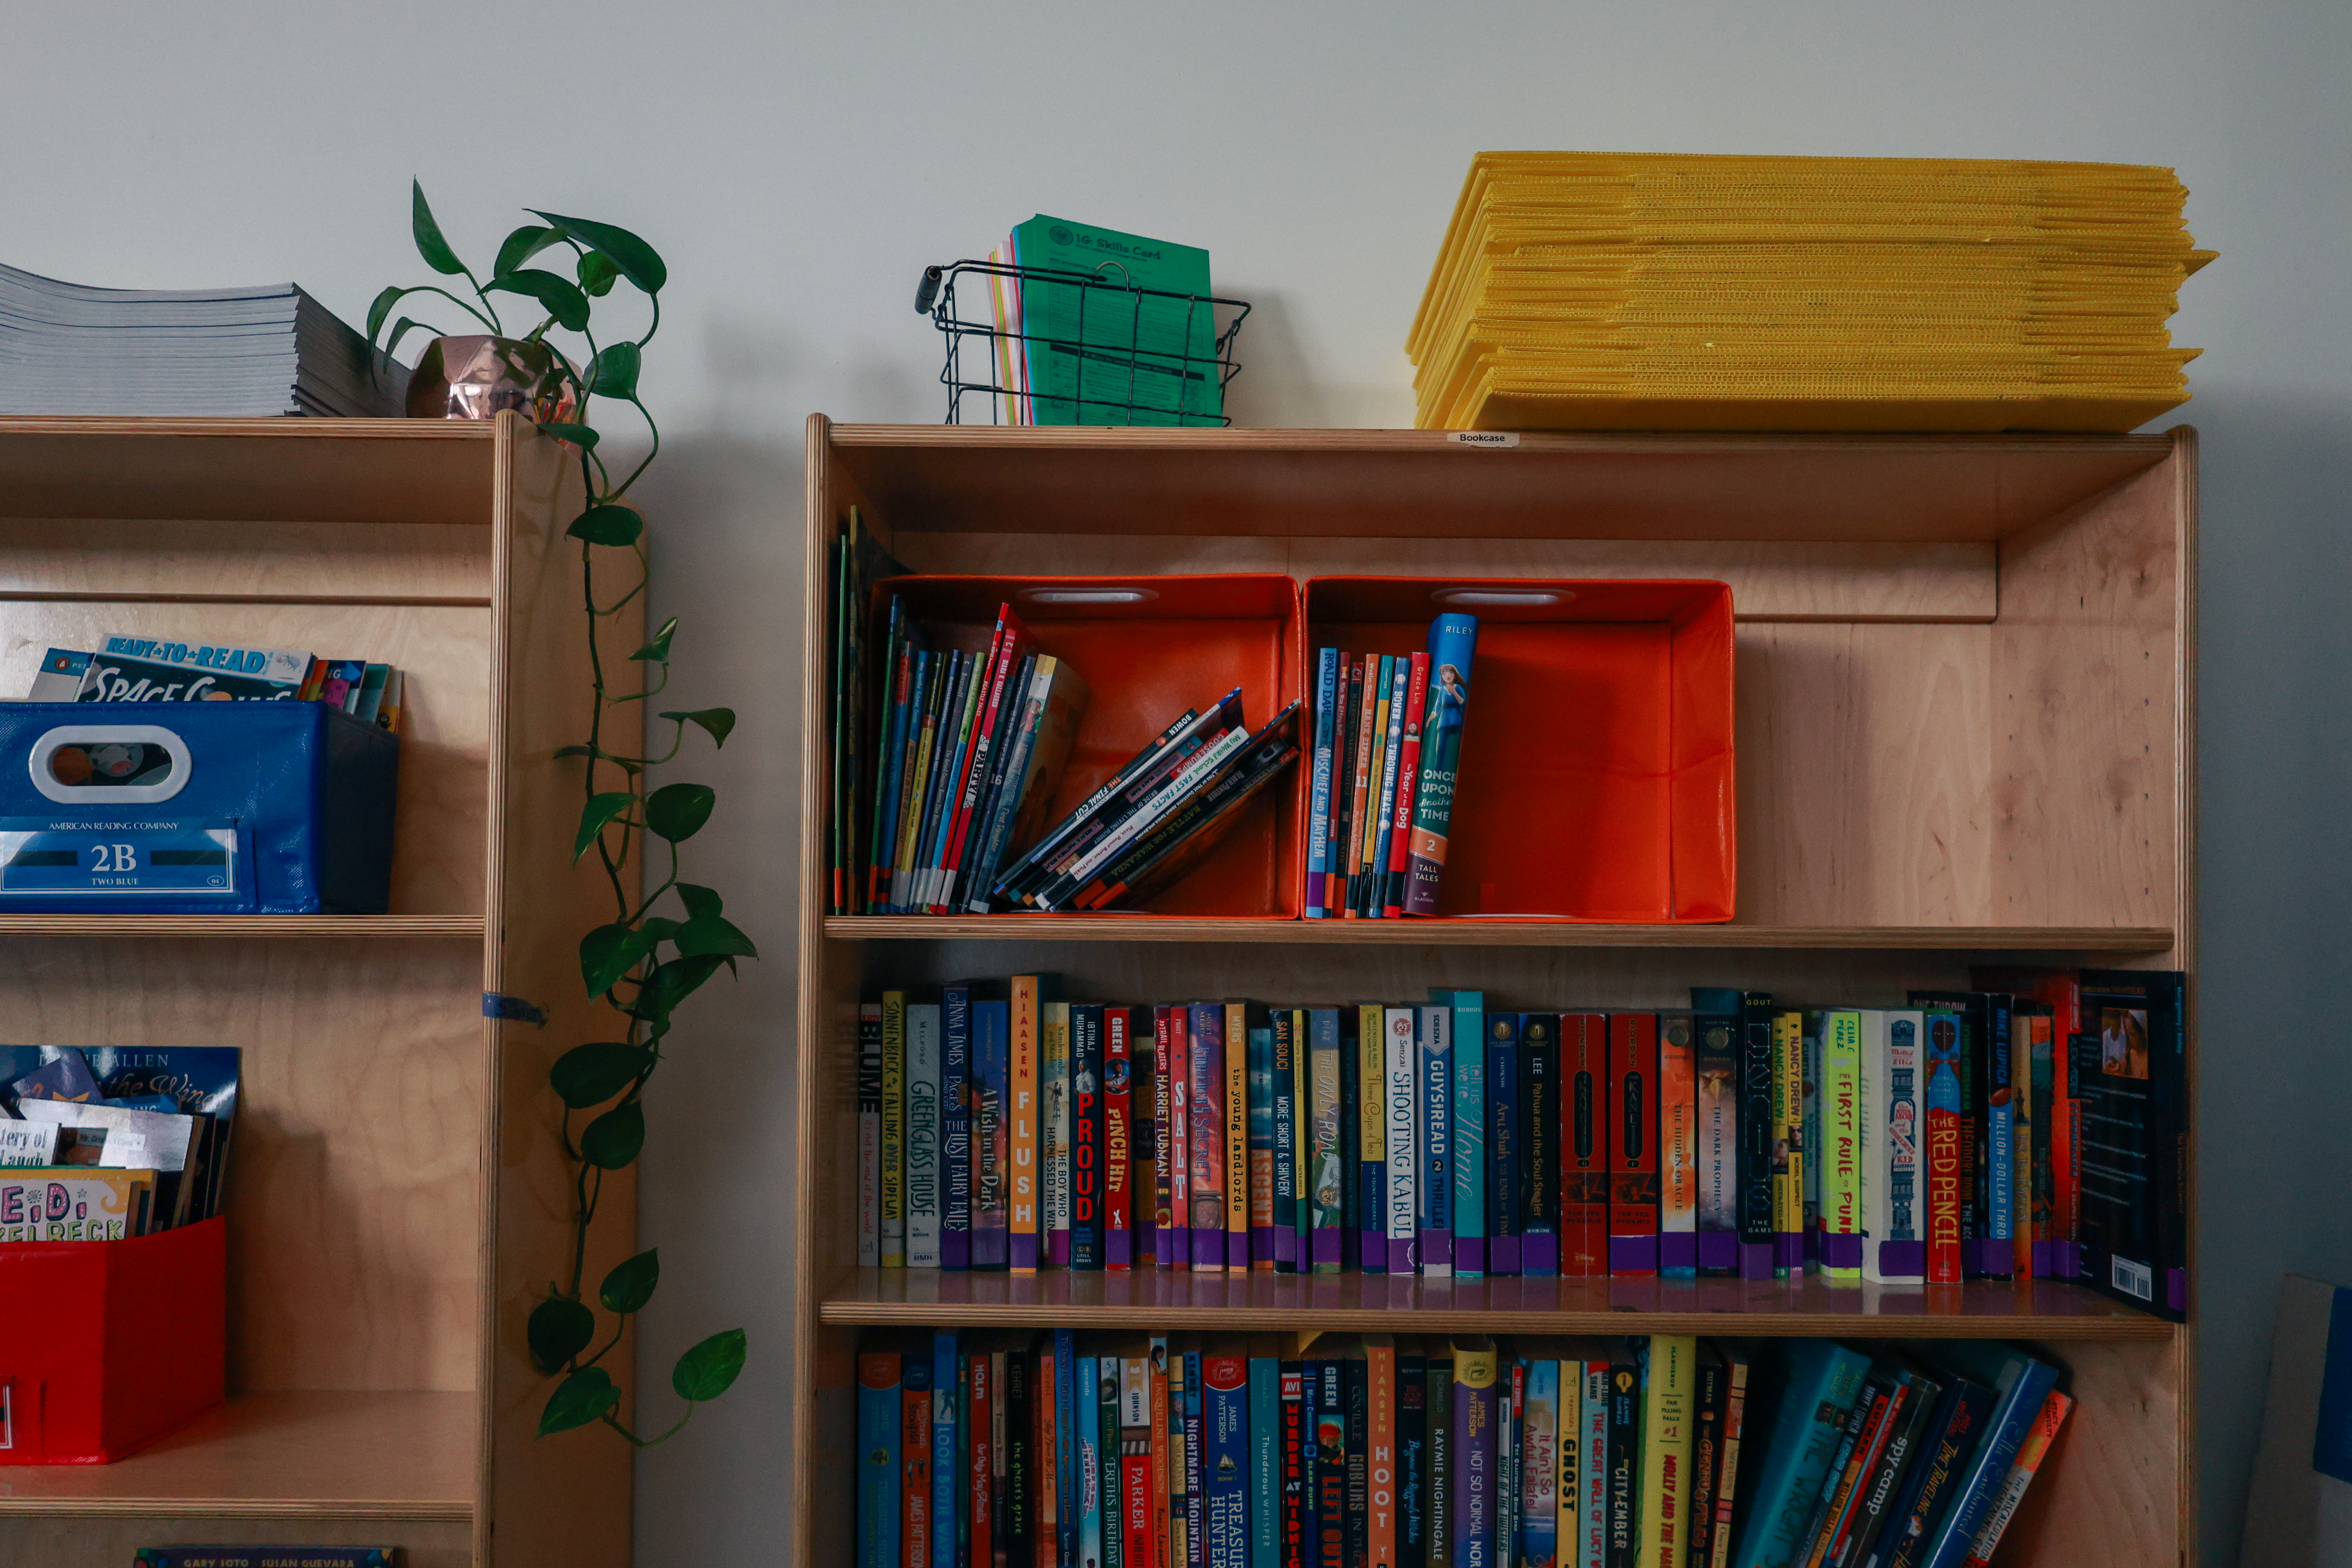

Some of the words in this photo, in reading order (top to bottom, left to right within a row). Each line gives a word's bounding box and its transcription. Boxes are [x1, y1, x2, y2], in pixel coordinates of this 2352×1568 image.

[1097, 239, 1128, 253] Skills
[1132, 247, 1161, 260] Card
[1445, 625, 1473, 636] RILEY
[106, 637, 154, 658] READY
[162, 643, 188, 662] TO
[197, 647, 267, 674] READ
[1323, 652, 1334, 686] ROALD
[95, 668, 183, 702] SPACE
[980, 681, 988, 699] BEASTLY
[1414, 666, 1423, 691] Grace
[1321, 690, 1333, 718] DAHL
[1391, 691, 1403, 720] BOWEN
[1413, 693, 1421, 704] Lin
[1168, 714, 1192, 735] BOWEN
[1177, 734, 1226, 776] GOOSEBUMPS
[1360, 734, 1370, 768] ZIPZER
[1384, 743, 1397, 788] THROWING
[990, 773, 1003, 785] 16
[1107, 776, 1122, 789] THE
[1175, 774, 1193, 792] FAST
[1317, 747, 1331, 793] MISCHIEF
[1423, 769, 1456, 782] ONCE
[1089, 785, 1109, 805] FINAL
[1136, 800, 1144, 809] OF
[1143, 789, 1158, 802] BRIDE
[1151, 789, 1175, 811] FACTS
[1316, 795, 1326, 812] AND
[1381, 791, 1392, 813] HEAT
[1421, 783, 1454, 795] UPON
[133, 822, 179, 831] COMPANY
[1075, 803, 1090, 820] CUT
[1111, 814, 1128, 831] LIVING
[1127, 805, 1138, 816] THE
[1421, 808, 1449, 821] TIME
[1094, 828, 1112, 845] DUMMY
[1314, 814, 1327, 857] MAYHEM
[1427, 840, 1435, 852] 2
[91, 844, 137, 872] 2B
[1419, 864, 1437, 873] TALL
[1415, 873, 1439, 882] TALES
[948, 992, 966, 1029] ANNA
[1996, 1008, 2008, 1039] MIKE
[1020, 990, 1028, 1078] HIAASEN
[1076, 1014, 1085, 1058] MUHAMMAD
[1087, 1021, 1095, 1051] IBTIHAJ
[1112, 1017, 1123, 1053] GREEN
[1276, 1021, 1287, 1039] SAN
[116, 1053, 169, 1067] ALLEN
[948, 1031, 966, 1066] JAMES
[1276, 1043, 1289, 1070] SOUCI
[1320, 1051, 1333, 1070] THE
[1774, 1039, 1784, 1080] NANCY
[1790, 1036, 1800, 1078] NANCY
[1996, 1042, 2008, 1084] LUPICA
[859, 1022, 882, 1112] BLUME
[1533, 1058, 1542, 1075] LEE
[983, 1088, 997, 1096] A
[1157, 1074, 1170, 1123] HARRIET
[1277, 1096, 1289, 1119] MORE
[1318, 1075, 1336, 1116] ONLY
[1774, 1083, 1784, 1119] DREW
[1790, 1081, 1800, 1116] DREW
[910, 1080, 936, 1169] GREENGLASS
[981, 1100, 999, 1135] Wish
[1231, 1091, 1242, 1131] young
[1392, 1072, 1412, 1168] SHOOTING
[1931, 1117, 1956, 1128] THE
[983, 1137, 997, 1150] in
[1108, 1108, 1126, 1161] PINCH
[1175, 1081, 1185, 1199] SALT
[1278, 1122, 1289, 1149] SHORT
[1319, 1120, 1337, 1160] ROAD
[1674, 1128, 1683, 1167] HIDDEN
[1932, 1130, 1957, 1172] RED
[983, 1153, 996, 1171] the
[1016, 1092, 1031, 1222] FLUSH
[1058, 1149, 1067, 1168] THE
[1077, 1093, 1094, 1221] PROUD
[1157, 1127, 1169, 1177] TUBMAN
[1434, 1161, 1442, 1171] 2
[1058, 1171, 1067, 1191] BOY
[1108, 1164, 1126, 1192] HIT
[1233, 1136, 1243, 1212] landlords
[1278, 1163, 1290, 1197] SHIVERY
[910, 1174, 935, 1216] HOUSE
[980, 1175, 998, 1210] Dark
[1058, 1193, 1067, 1217] WHO
[1393, 1174, 1412, 1238] KABUL
[1932, 1177, 1958, 1250] PENCIL
[975, 1364, 985, 1399] HOLM
[1284, 1381, 1299, 1392] AVI
[1325, 1366, 1337, 1406] GREEN
[1377, 1351, 1386, 1433] HIAASEN
[1589, 1376, 1597, 1399] SHANG
[1218, 1395, 1226, 1443] PATTERSON
[1351, 1385, 1362, 1441] COVILLE
[1469, 1391, 1478, 1437] PATTERSON
[1477, 1400, 1486, 1428] JAMES
[1187, 1419, 1198, 1492] NIGHTMARE
[1262, 1436, 1270, 1495] Thunderous
[1434, 1428, 1444, 1473] RAYMIE
[1470, 1450, 1483, 1472] NOT
[1374, 1446, 1390, 1528] HOOT
[1470, 1475, 1483, 1491] SO
[1562, 1439, 1576, 1512] GHOST
[1615, 1467, 1629, 1497] CITY
[1663, 1454, 1677, 1493] MOLLY
[1131, 1467, 1144, 1530] PARKER
[1322, 1476, 1342, 1524] LEFT
[1470, 1494, 1482, 1537] NORMAL
[1662, 1493, 1676, 1519] AND
[1188, 1498, 1199, 1563] MOUNTAIN
[1433, 1477, 1444, 1561] NIGHTINGALE
[1614, 1500, 1628, 1549] EMBER
[1661, 1522, 1674, 1545] THE
[183, 1559, 215, 1568] GARY
[220, 1559, 249, 1568] SOTO
[262, 1559, 297, 1568] SUSAN
[301, 1559, 355, 1568] GUEVARA
[1322, 1528, 1343, 1568] OUT
